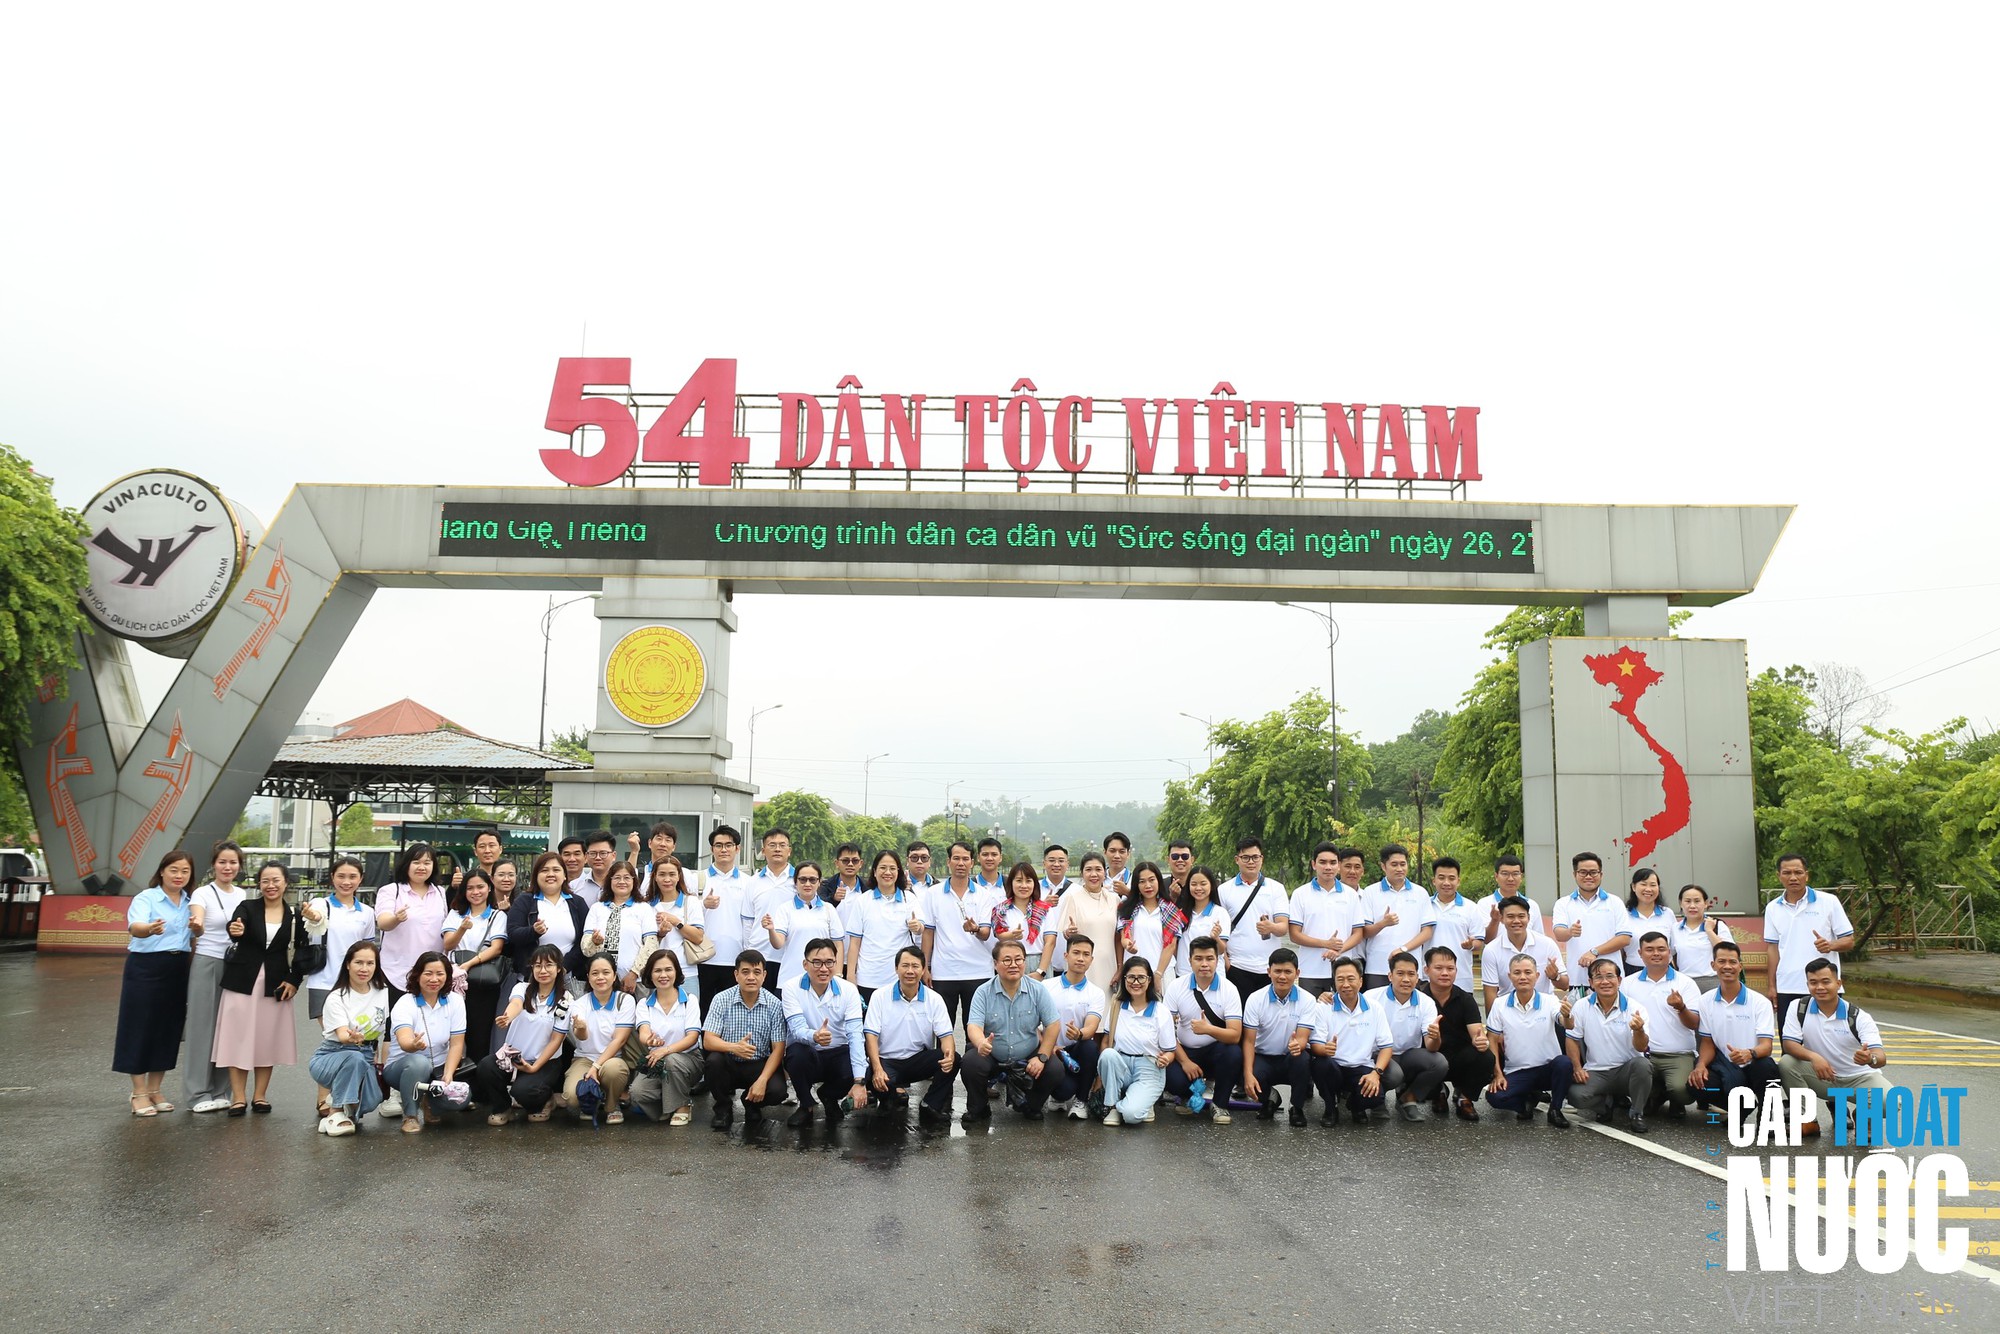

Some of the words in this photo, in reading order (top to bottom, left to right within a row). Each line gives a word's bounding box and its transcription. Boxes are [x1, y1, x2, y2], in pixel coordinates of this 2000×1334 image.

[539, 357, 751, 487] 54
[775, 375, 927, 470] DÂN
[954, 377, 1094, 488] TỘC
[1121, 381, 1296, 491] VIỆT
[1322, 402, 1483, 481] NAM
[102, 483, 207, 514] VINACULTO
[835, 520, 897, 545] trình
[905, 521, 957, 546] dân
[965, 526, 998, 547] ca
[1006, 522, 1057, 548] dân
[1065, 523, 1098, 548] vũ
[1106, 524, 1175, 550] "Sức
[1181, 521, 1247, 557] sống
[1255, 527, 1297, 556] đại
[1304, 528, 1382, 559] ngàn"
[1389, 530, 1454, 561] ngày
[1462, 530, 1504, 560] 26,
[1510, 531, 1534, 556] 2
[125, 620, 147, 632] LỊCH
[149, 620, 170, 632] CÁC
[170, 612, 191, 628] DÂN
[216, 557, 229, 579] NAM
